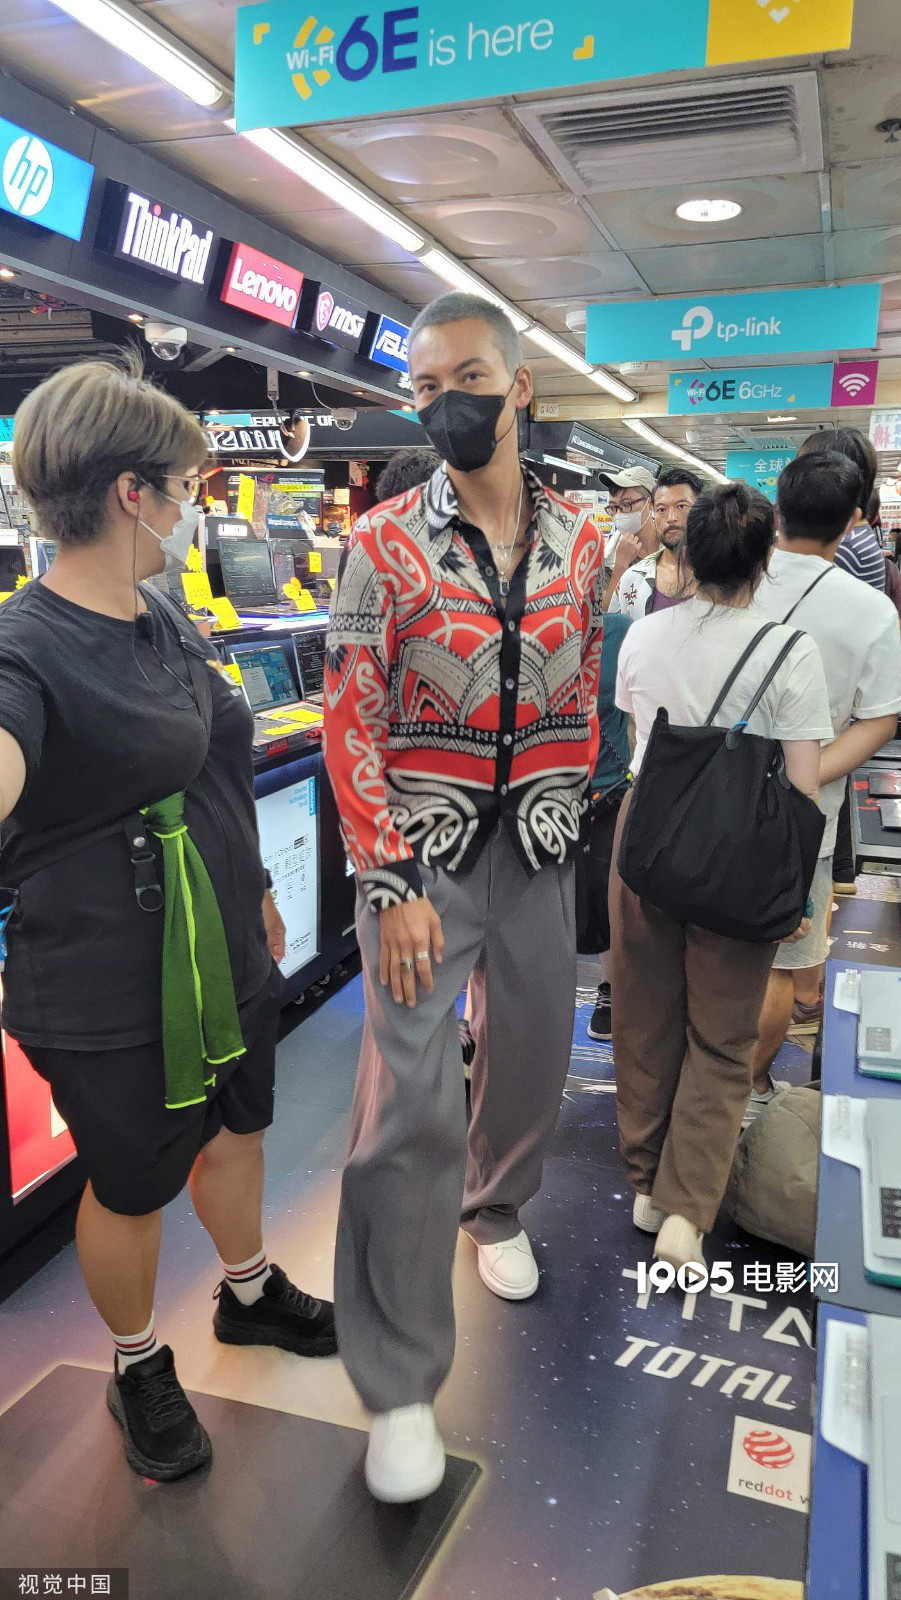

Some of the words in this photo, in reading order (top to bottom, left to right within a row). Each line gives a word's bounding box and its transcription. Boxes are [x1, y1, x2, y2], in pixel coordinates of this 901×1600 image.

[286, 45, 334, 71] Wi-Fi
[336, 6, 419, 82] 6E
[429, 28, 456, 67] is
[468, 18, 554, 61] here
[9, 138, 49, 212] hp
[121, 191, 214, 285] ThinkPad
[230, 257, 297, 312] Lenovo
[329, 305, 365, 338] msi
[717, 316, 781, 342] tp-link
[705, 379, 736, 402] 6E
[754, 456, 792, 474] 全球
[614, 1335, 797, 1411] TOTAL
